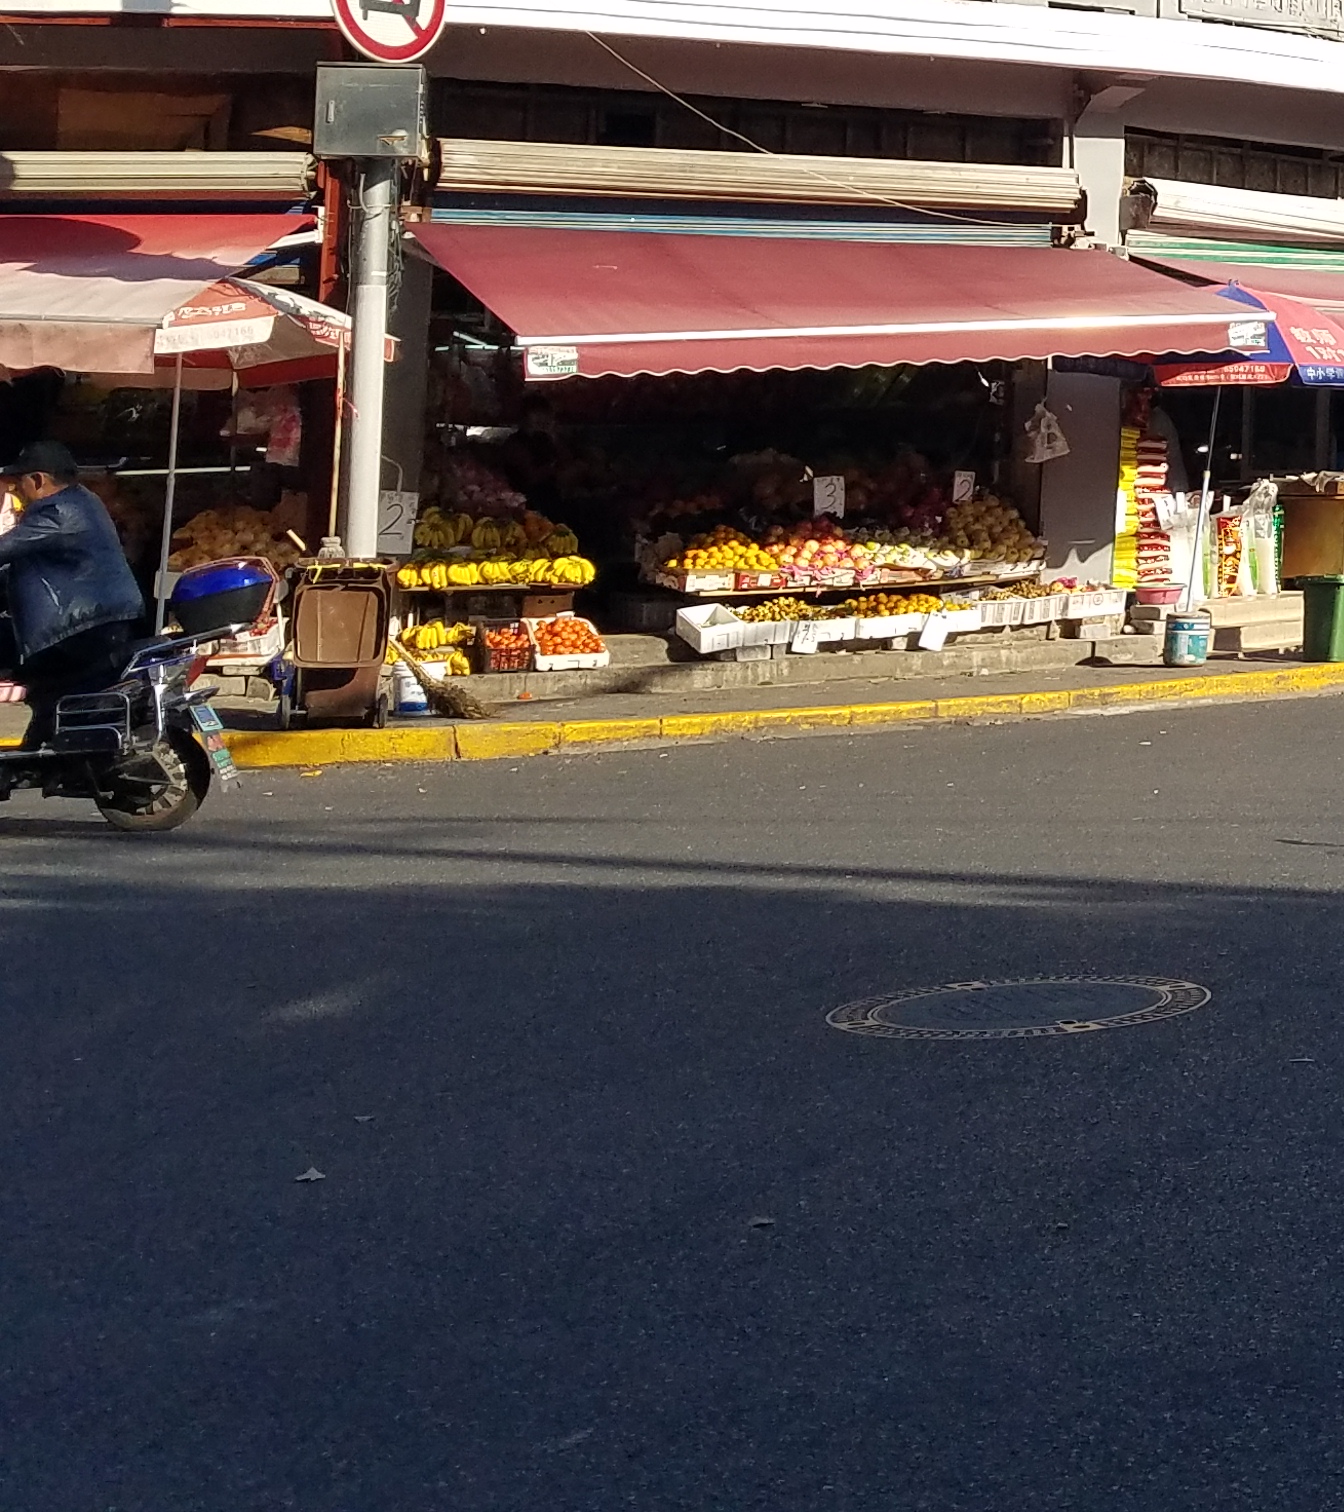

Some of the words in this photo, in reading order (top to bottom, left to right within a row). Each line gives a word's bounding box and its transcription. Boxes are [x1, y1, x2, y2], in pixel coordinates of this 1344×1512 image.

[820, 482, 837, 510] 3
[956, 478, 972, 502] 2
[378, 503, 404, 536] 2
